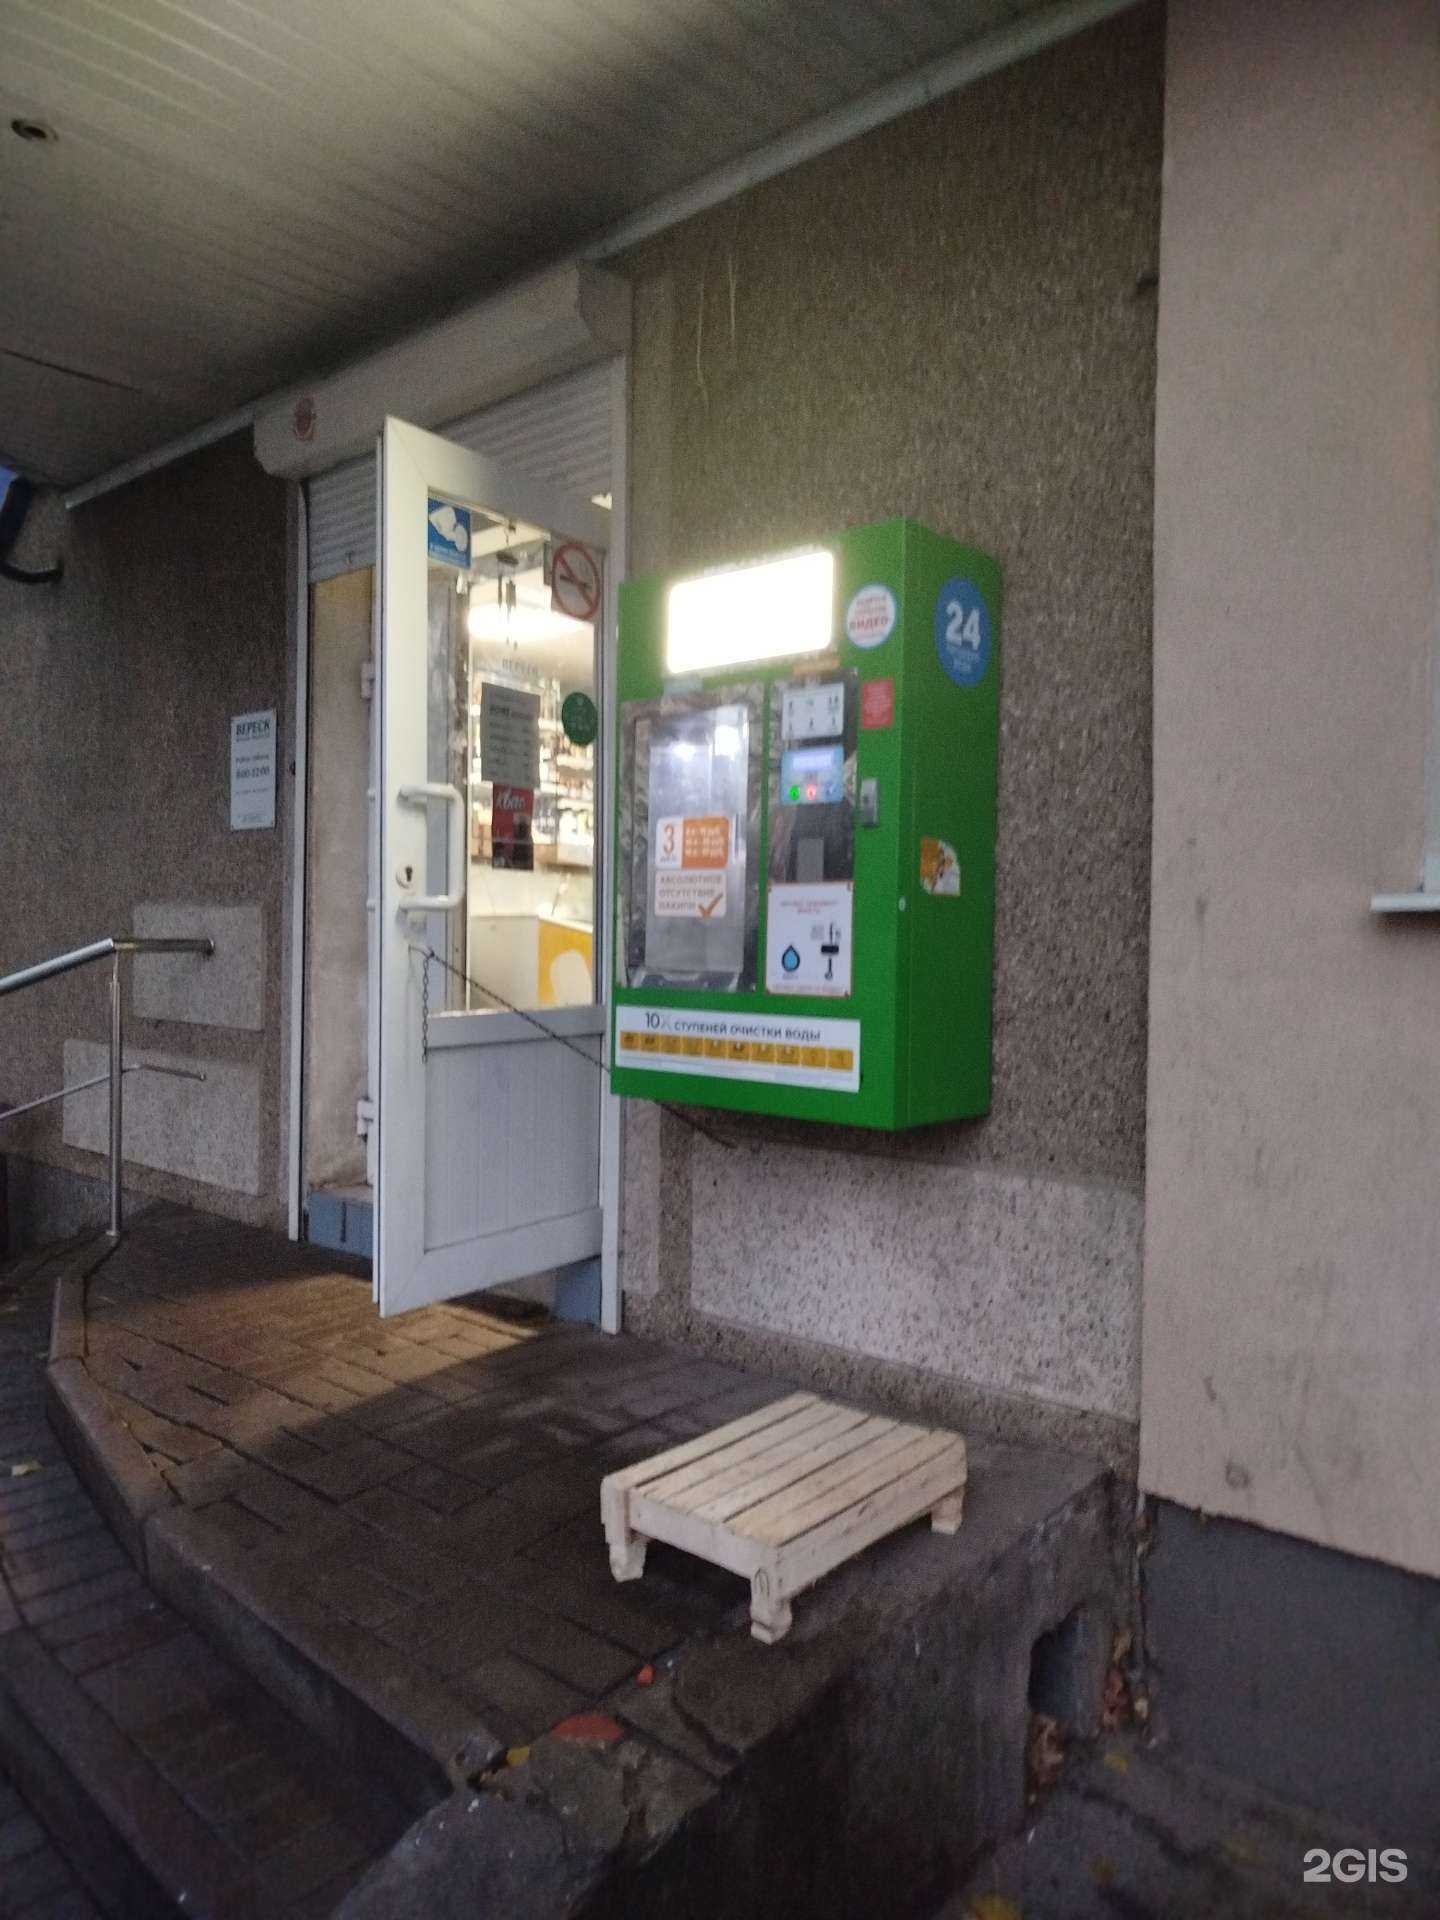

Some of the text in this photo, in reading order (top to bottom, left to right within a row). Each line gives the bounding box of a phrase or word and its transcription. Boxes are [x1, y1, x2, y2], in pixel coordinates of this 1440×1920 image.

[945, 598, 981, 651] 24
[663, 823, 675, 855] 3
[674, 1021, 727, 1034] СТУПЕНЕЙ
[730, 1025, 782, 1038] ОЧИСТКИ
[785, 1028, 821, 1041] ВОДЫ
